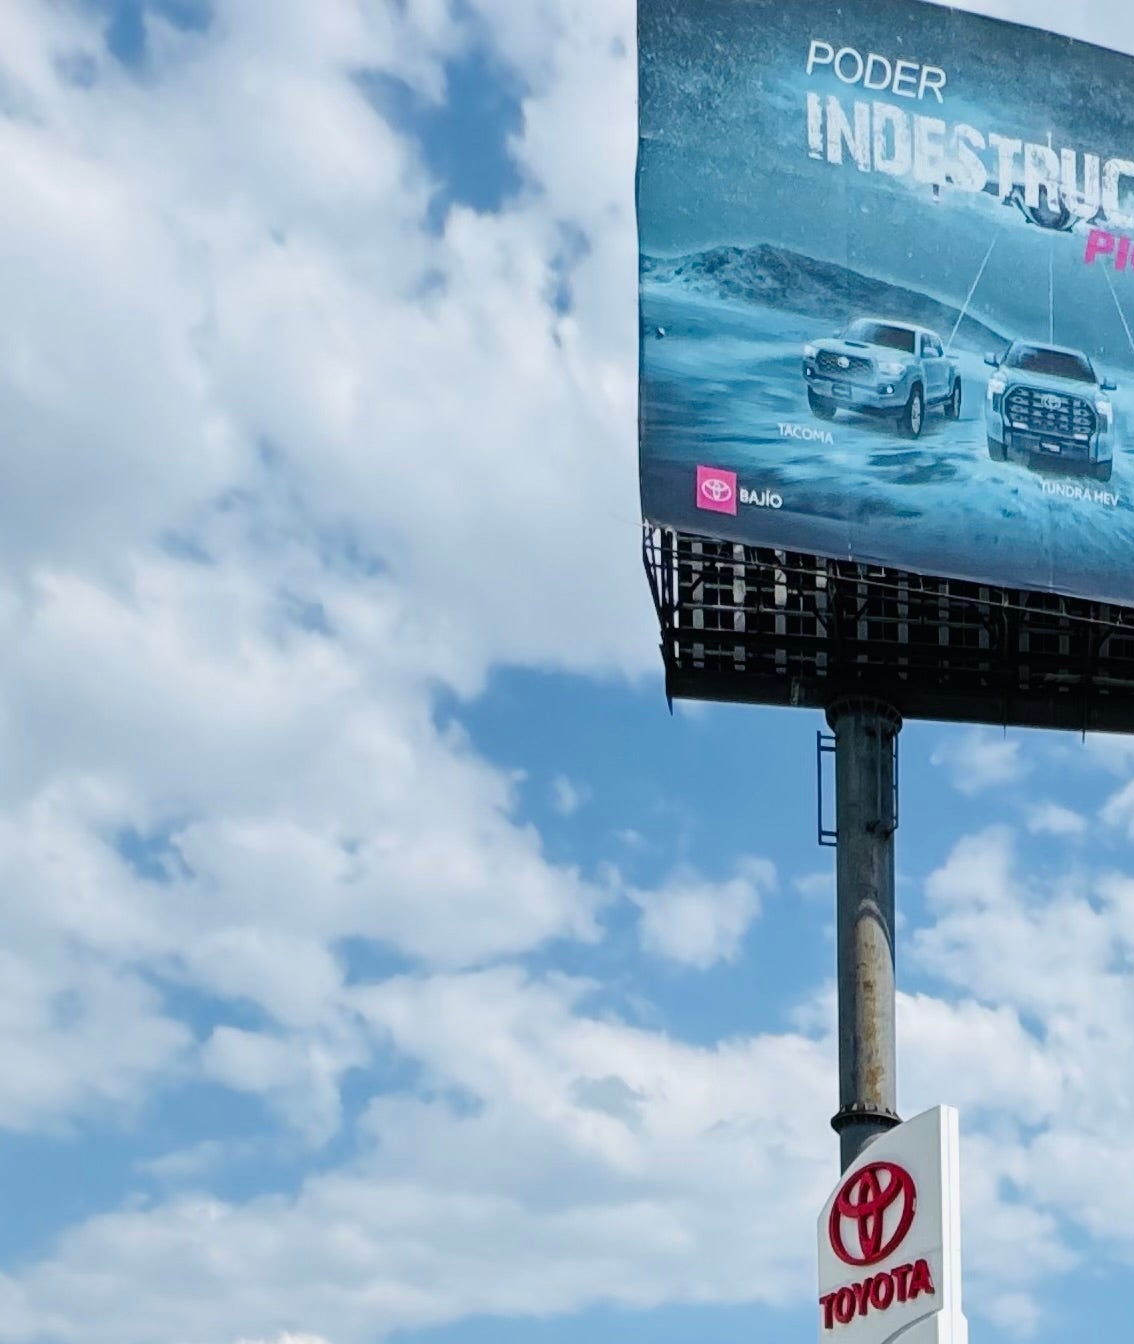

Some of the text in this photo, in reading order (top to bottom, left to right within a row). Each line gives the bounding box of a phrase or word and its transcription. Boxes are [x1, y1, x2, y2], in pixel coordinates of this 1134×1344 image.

[804, 39, 947, 103] PODER
[777, 422, 834, 445] TACOMA
[740, 488, 783, 509] BAJÍO
[1041, 480, 1119, 507] TUNDRA HEV
[819, 1258, 935, 1330] TOYOTA
